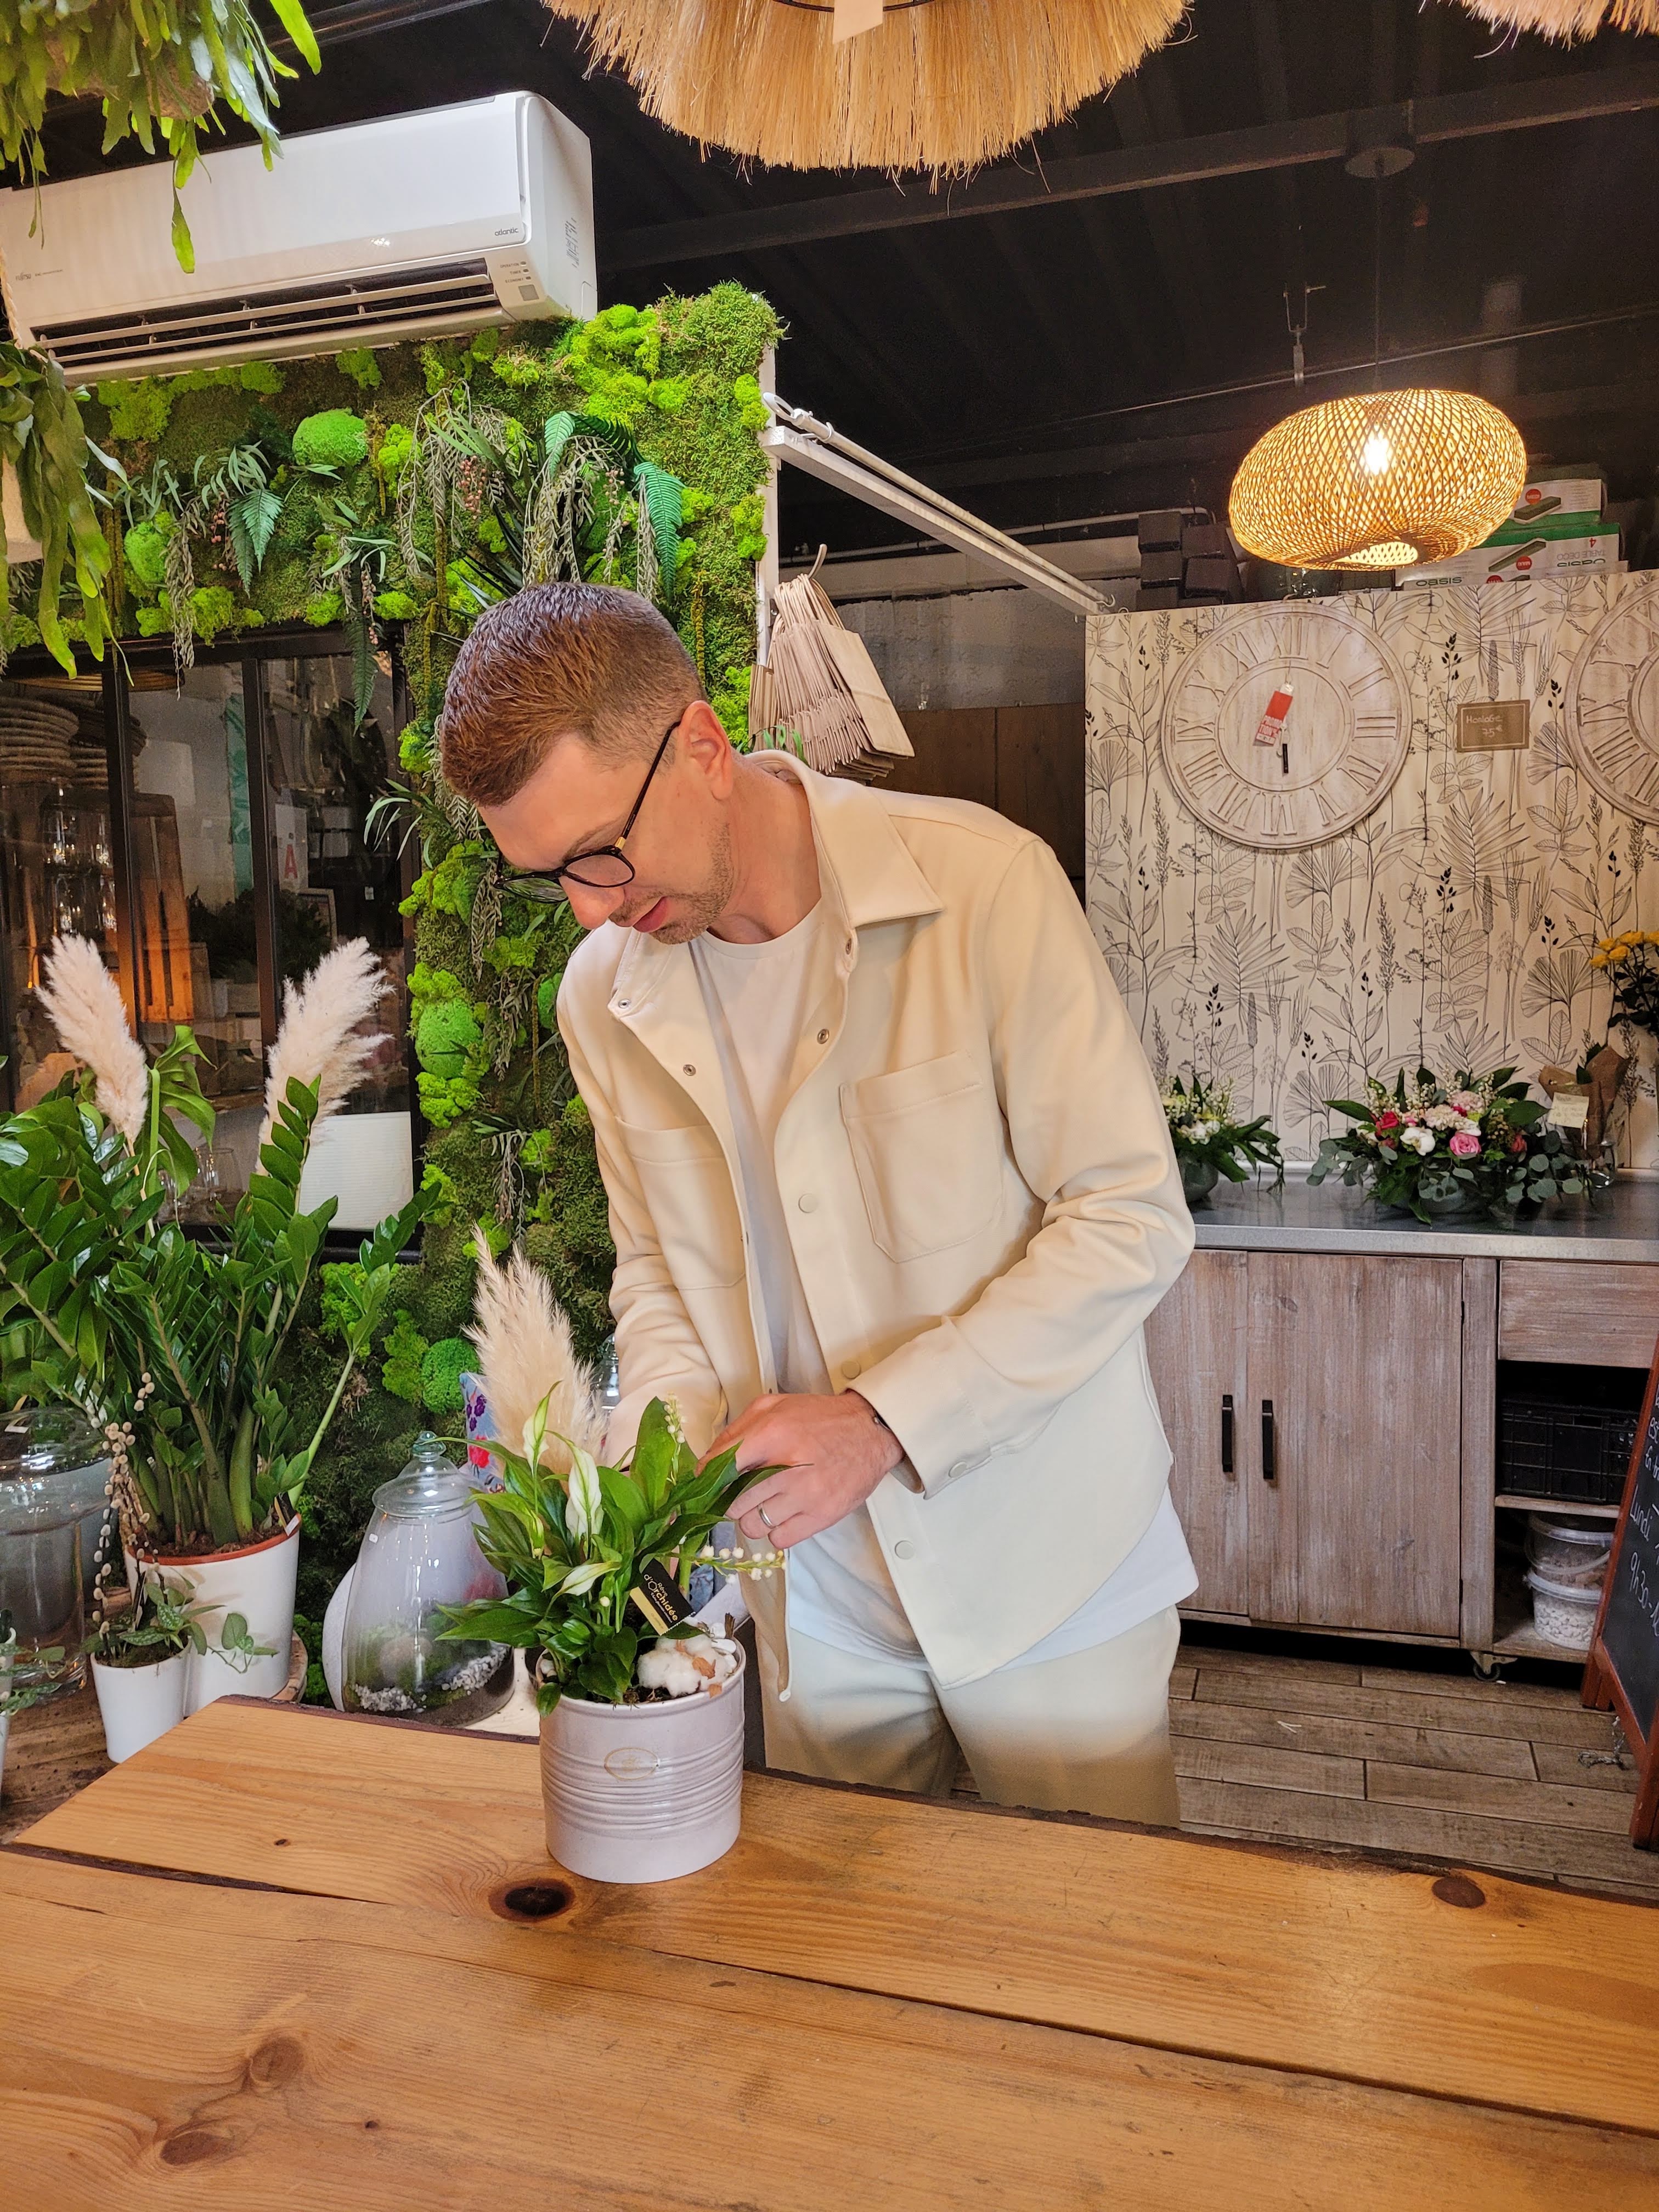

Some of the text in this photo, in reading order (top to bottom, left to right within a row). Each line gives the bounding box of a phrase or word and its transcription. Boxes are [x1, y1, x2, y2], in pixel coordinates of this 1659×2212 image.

[495, 227, 519, 236] atlantic
[1557, 550, 1605, 561] TABLE DECO
[1216, 629, 1262, 679] XI
[1264, 615, 1313, 661] XII
[1340, 658, 1390, 701] II
[1590, 638, 1639, 683] X
[1184, 668, 1227, 708] X
[1352, 707, 1399, 741] III
[1260, 792, 1297, 836] VI
[1310, 781, 1348, 826] V
[1630, 1484, 1652, 1542] Lundi
